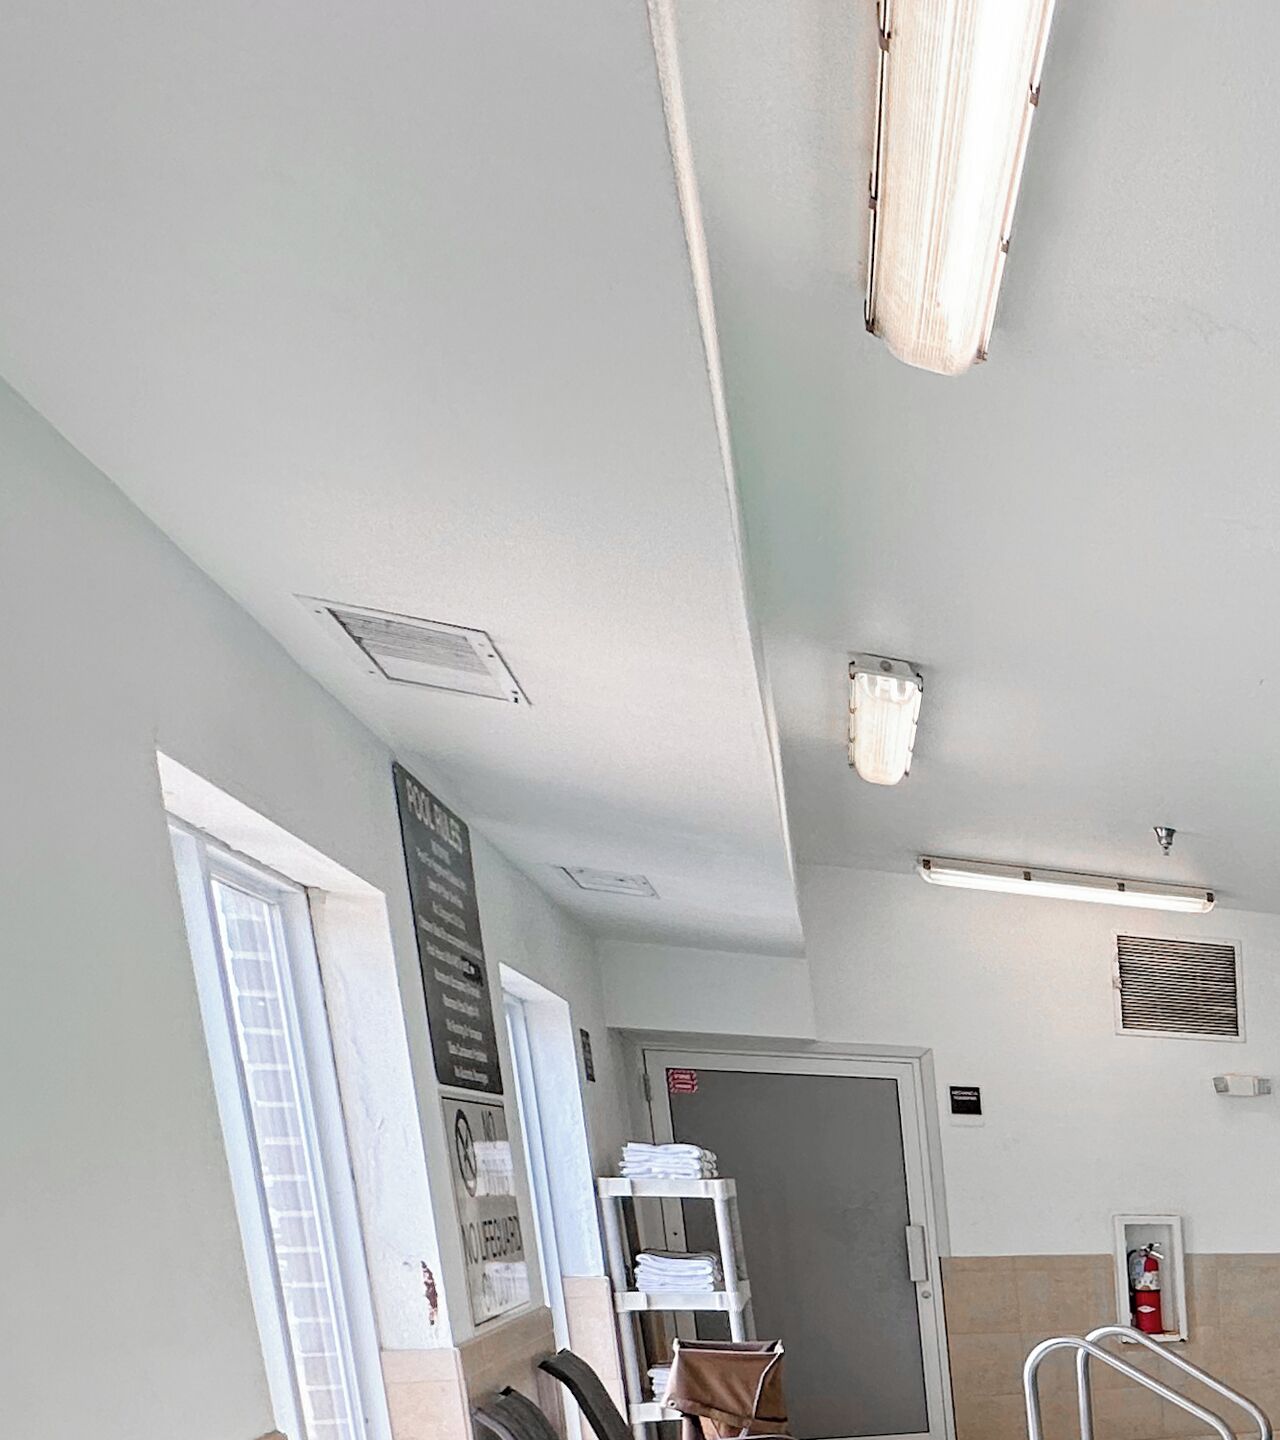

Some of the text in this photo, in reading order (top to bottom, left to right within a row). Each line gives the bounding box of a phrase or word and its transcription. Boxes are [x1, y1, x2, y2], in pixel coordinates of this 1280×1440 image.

[406, 779, 435, 830] POOL
[461, 1216, 523, 1266] NO LIFEGUARD
